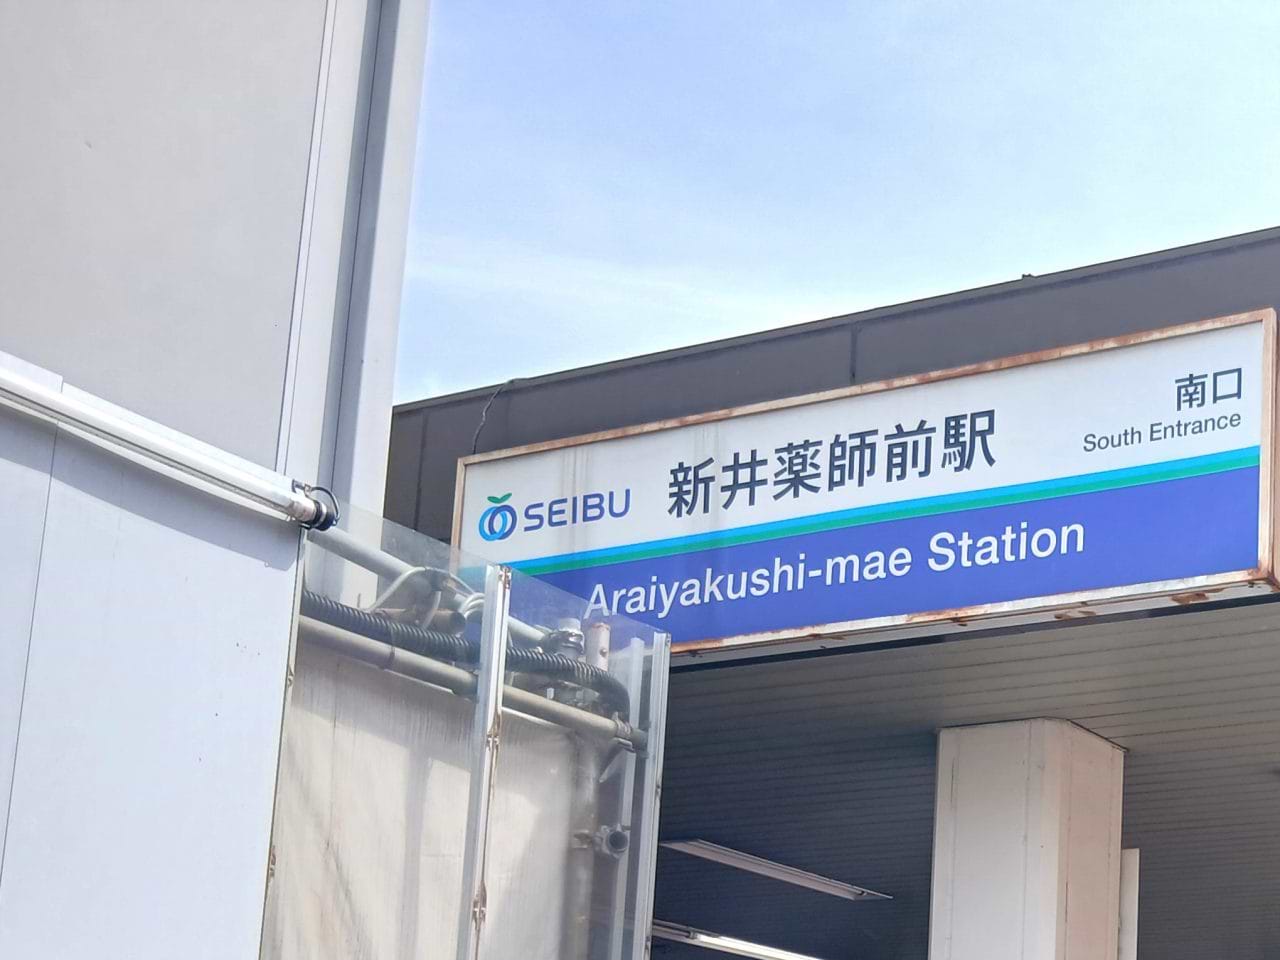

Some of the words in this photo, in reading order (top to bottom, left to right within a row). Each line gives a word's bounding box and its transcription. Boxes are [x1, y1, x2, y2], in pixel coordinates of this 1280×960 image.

[1175, 367, 1243, 412] 南口
[1083, 427, 1140, 453] South
[1149, 410, 1241, 441] Entrance
[668, 409, 997, 518] 新井薬師前駅
[523, 487, 632, 532] SEIBU
[583, 543, 911, 620] Araiyakushi-mae
[927, 520, 1085, 570] Station
